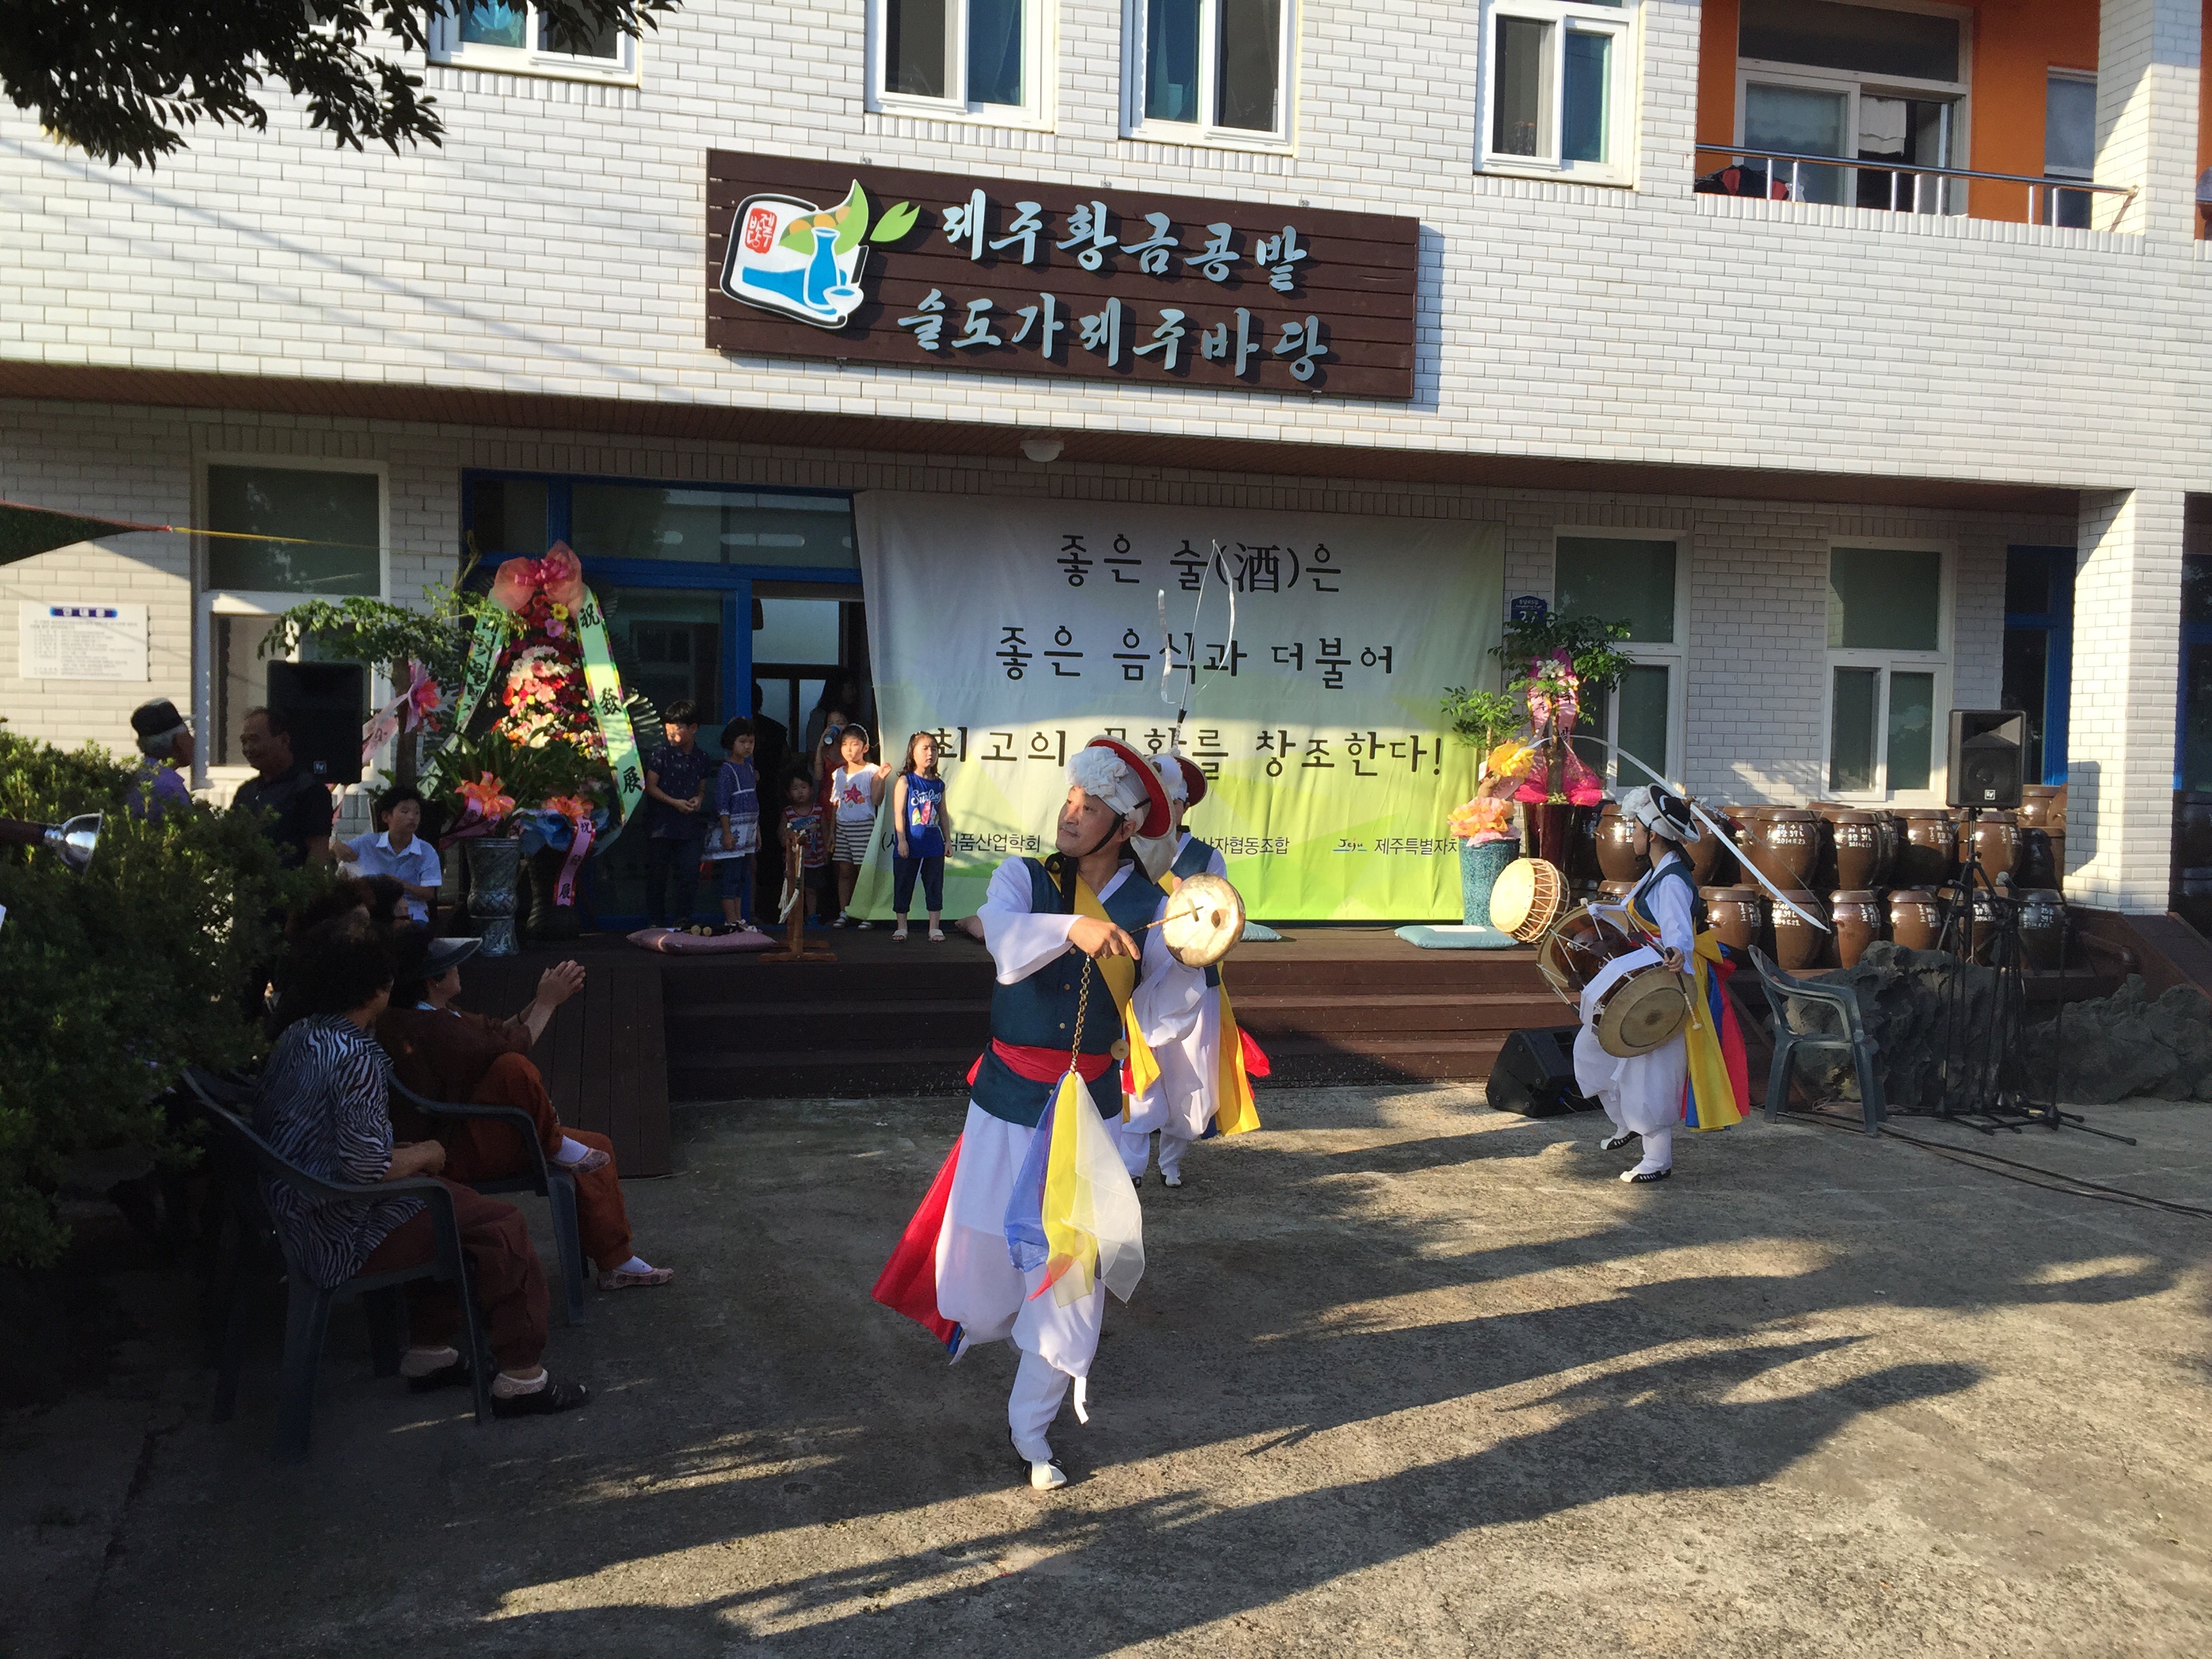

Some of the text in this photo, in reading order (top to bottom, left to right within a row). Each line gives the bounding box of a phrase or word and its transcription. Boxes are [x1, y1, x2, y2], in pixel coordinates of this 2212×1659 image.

[1057, 534, 1142, 587] 좋은
[996, 627, 1393, 690] 좋은 음식과 더불어
[937, 726, 1065, 767] 최고의
[1256, 729, 1441, 777] 창조한다!
